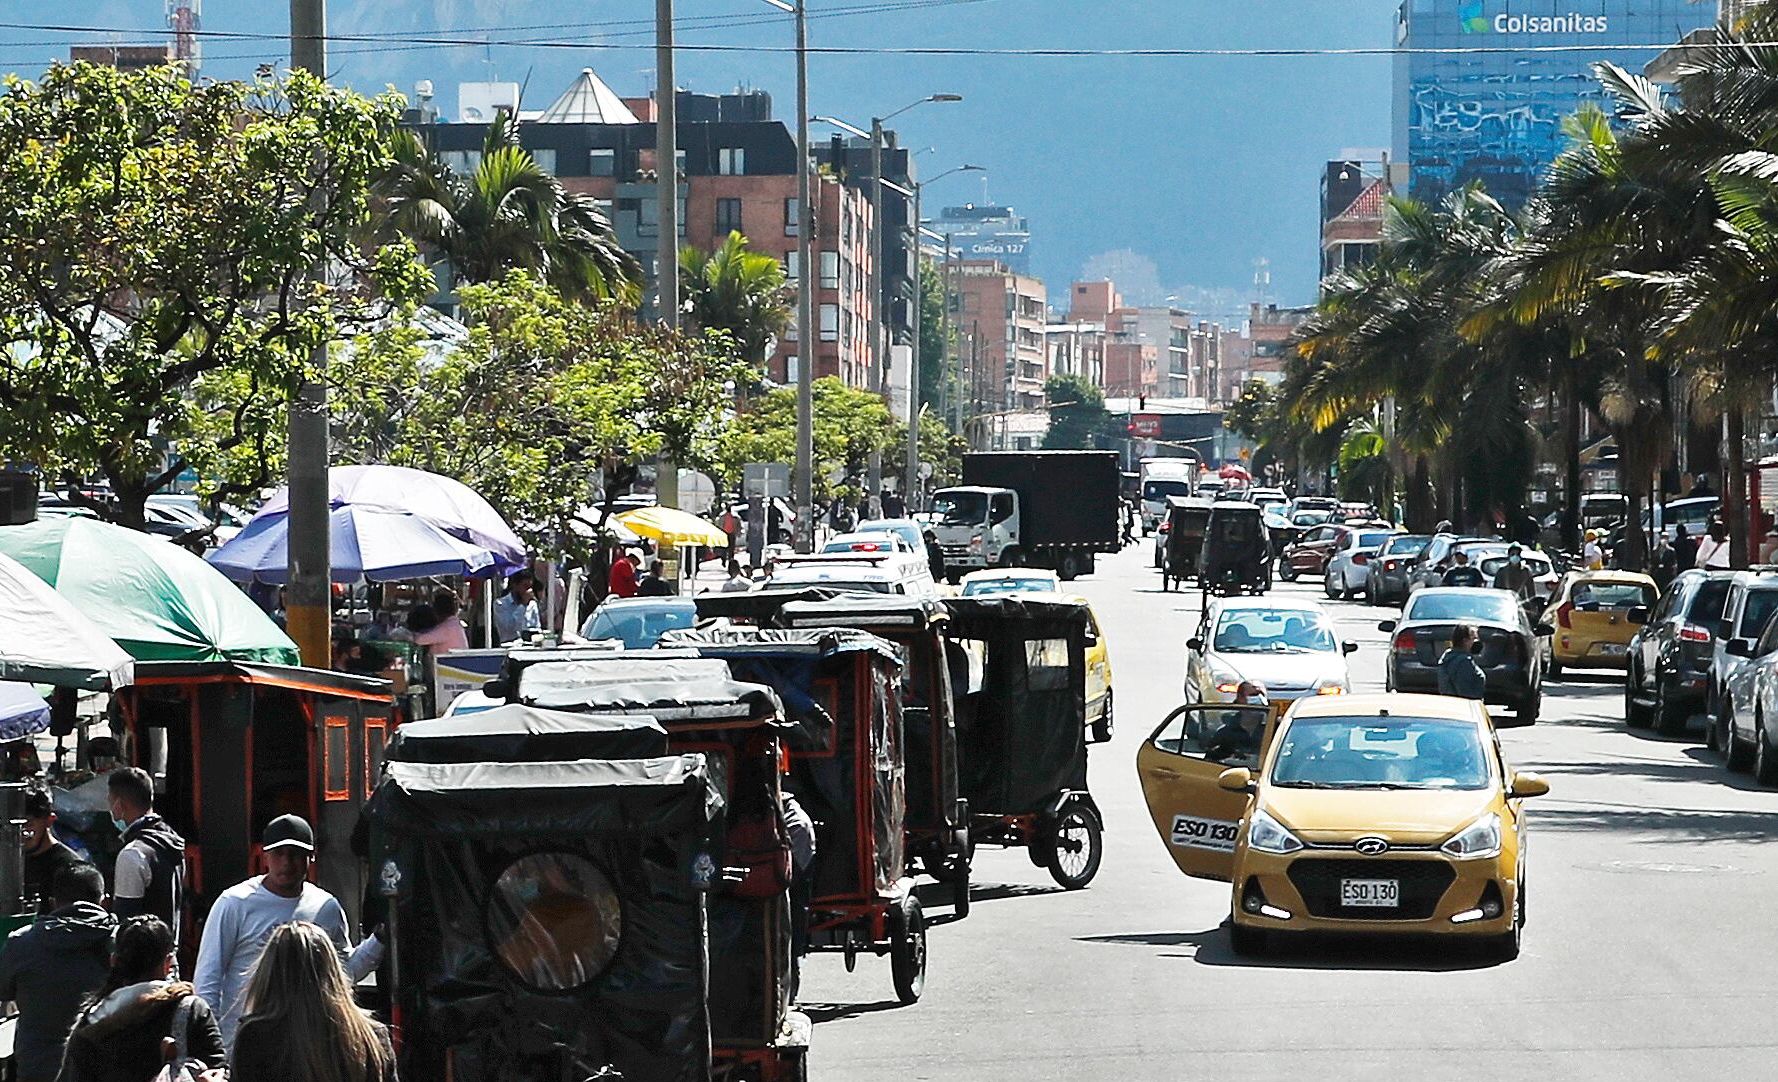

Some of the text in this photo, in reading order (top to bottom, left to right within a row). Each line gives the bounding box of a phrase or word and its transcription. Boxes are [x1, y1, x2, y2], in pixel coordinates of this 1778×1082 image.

[1494, 12, 1607, 33] Colsanitas
[1006, 244, 1024, 254] 127
[1173, 819, 1238, 841] ESO 130
[1343, 884, 1397, 900] ESO 130
